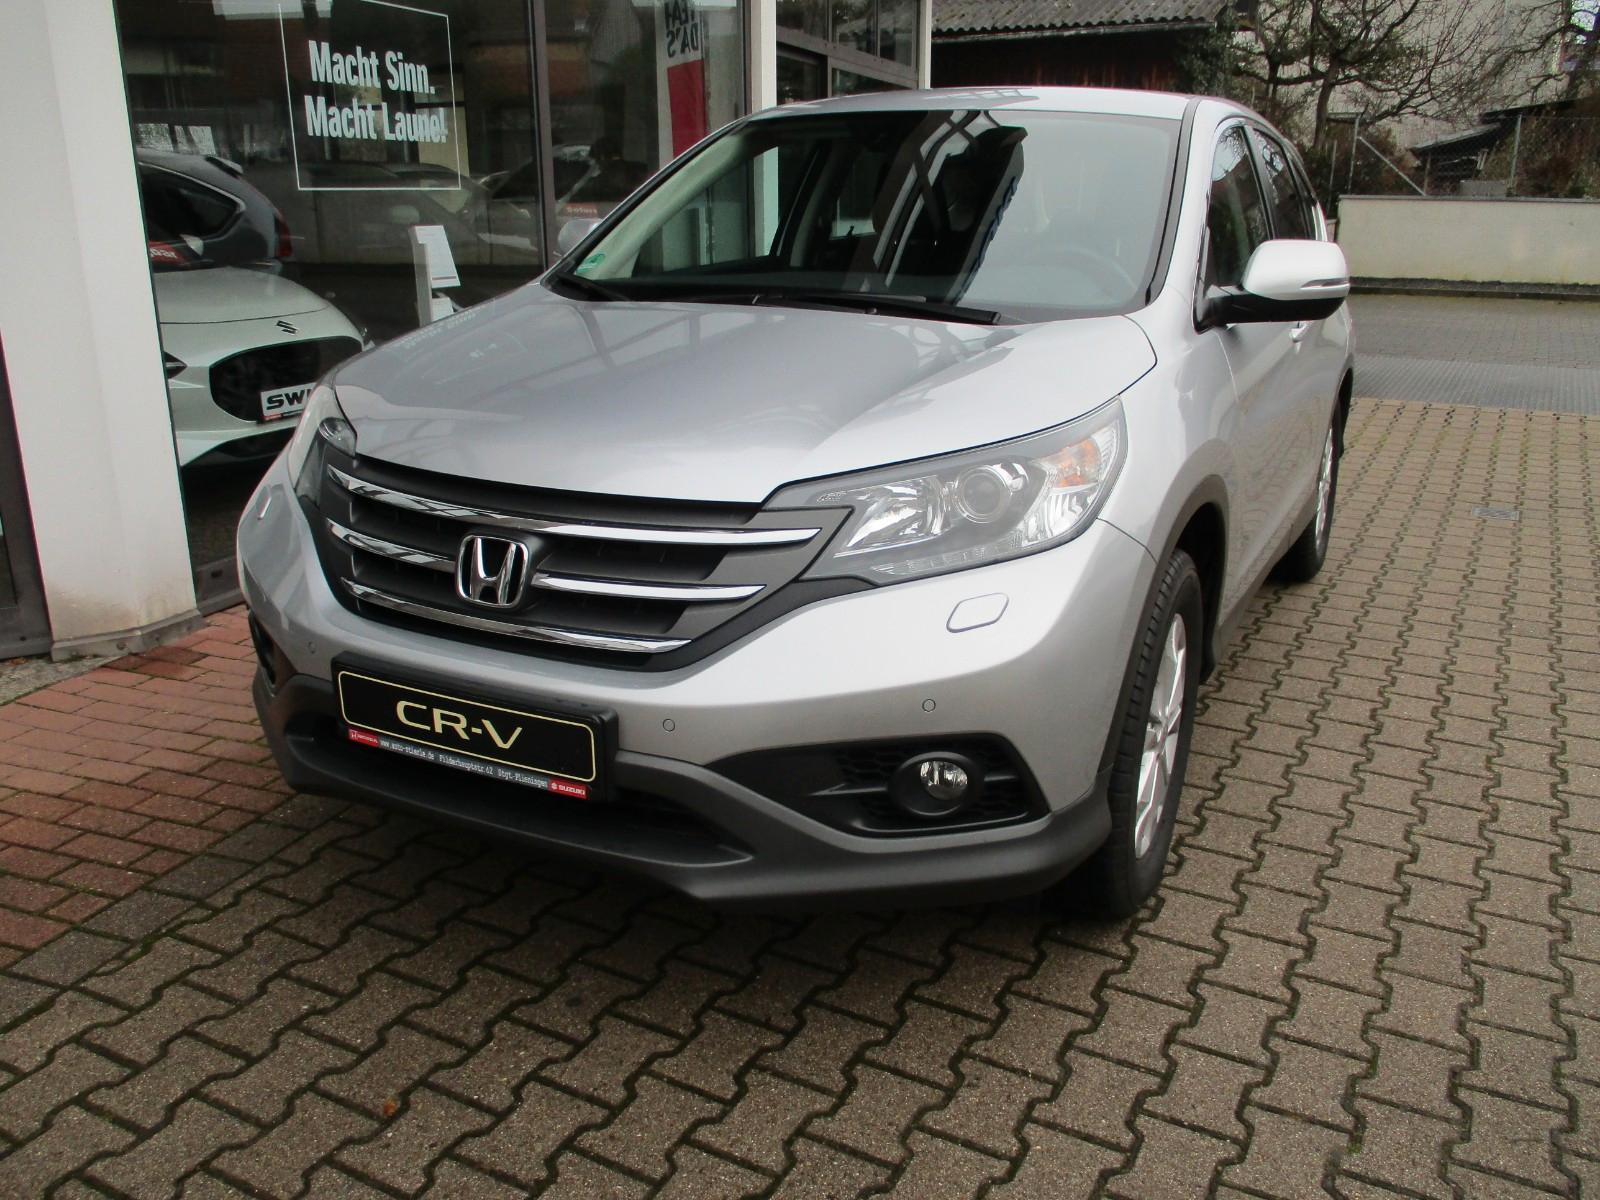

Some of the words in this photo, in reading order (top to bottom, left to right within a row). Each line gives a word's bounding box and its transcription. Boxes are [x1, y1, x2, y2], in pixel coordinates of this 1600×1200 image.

[308, 40, 381, 89] Macht
[385, 50, 436, 95] Sinn.
[304, 95, 378, 140] Macht
[382, 101, 449, 143] Laune!
[396, 700, 523, 750] CR-V
[558, 784, 586, 796] SUZUKI
